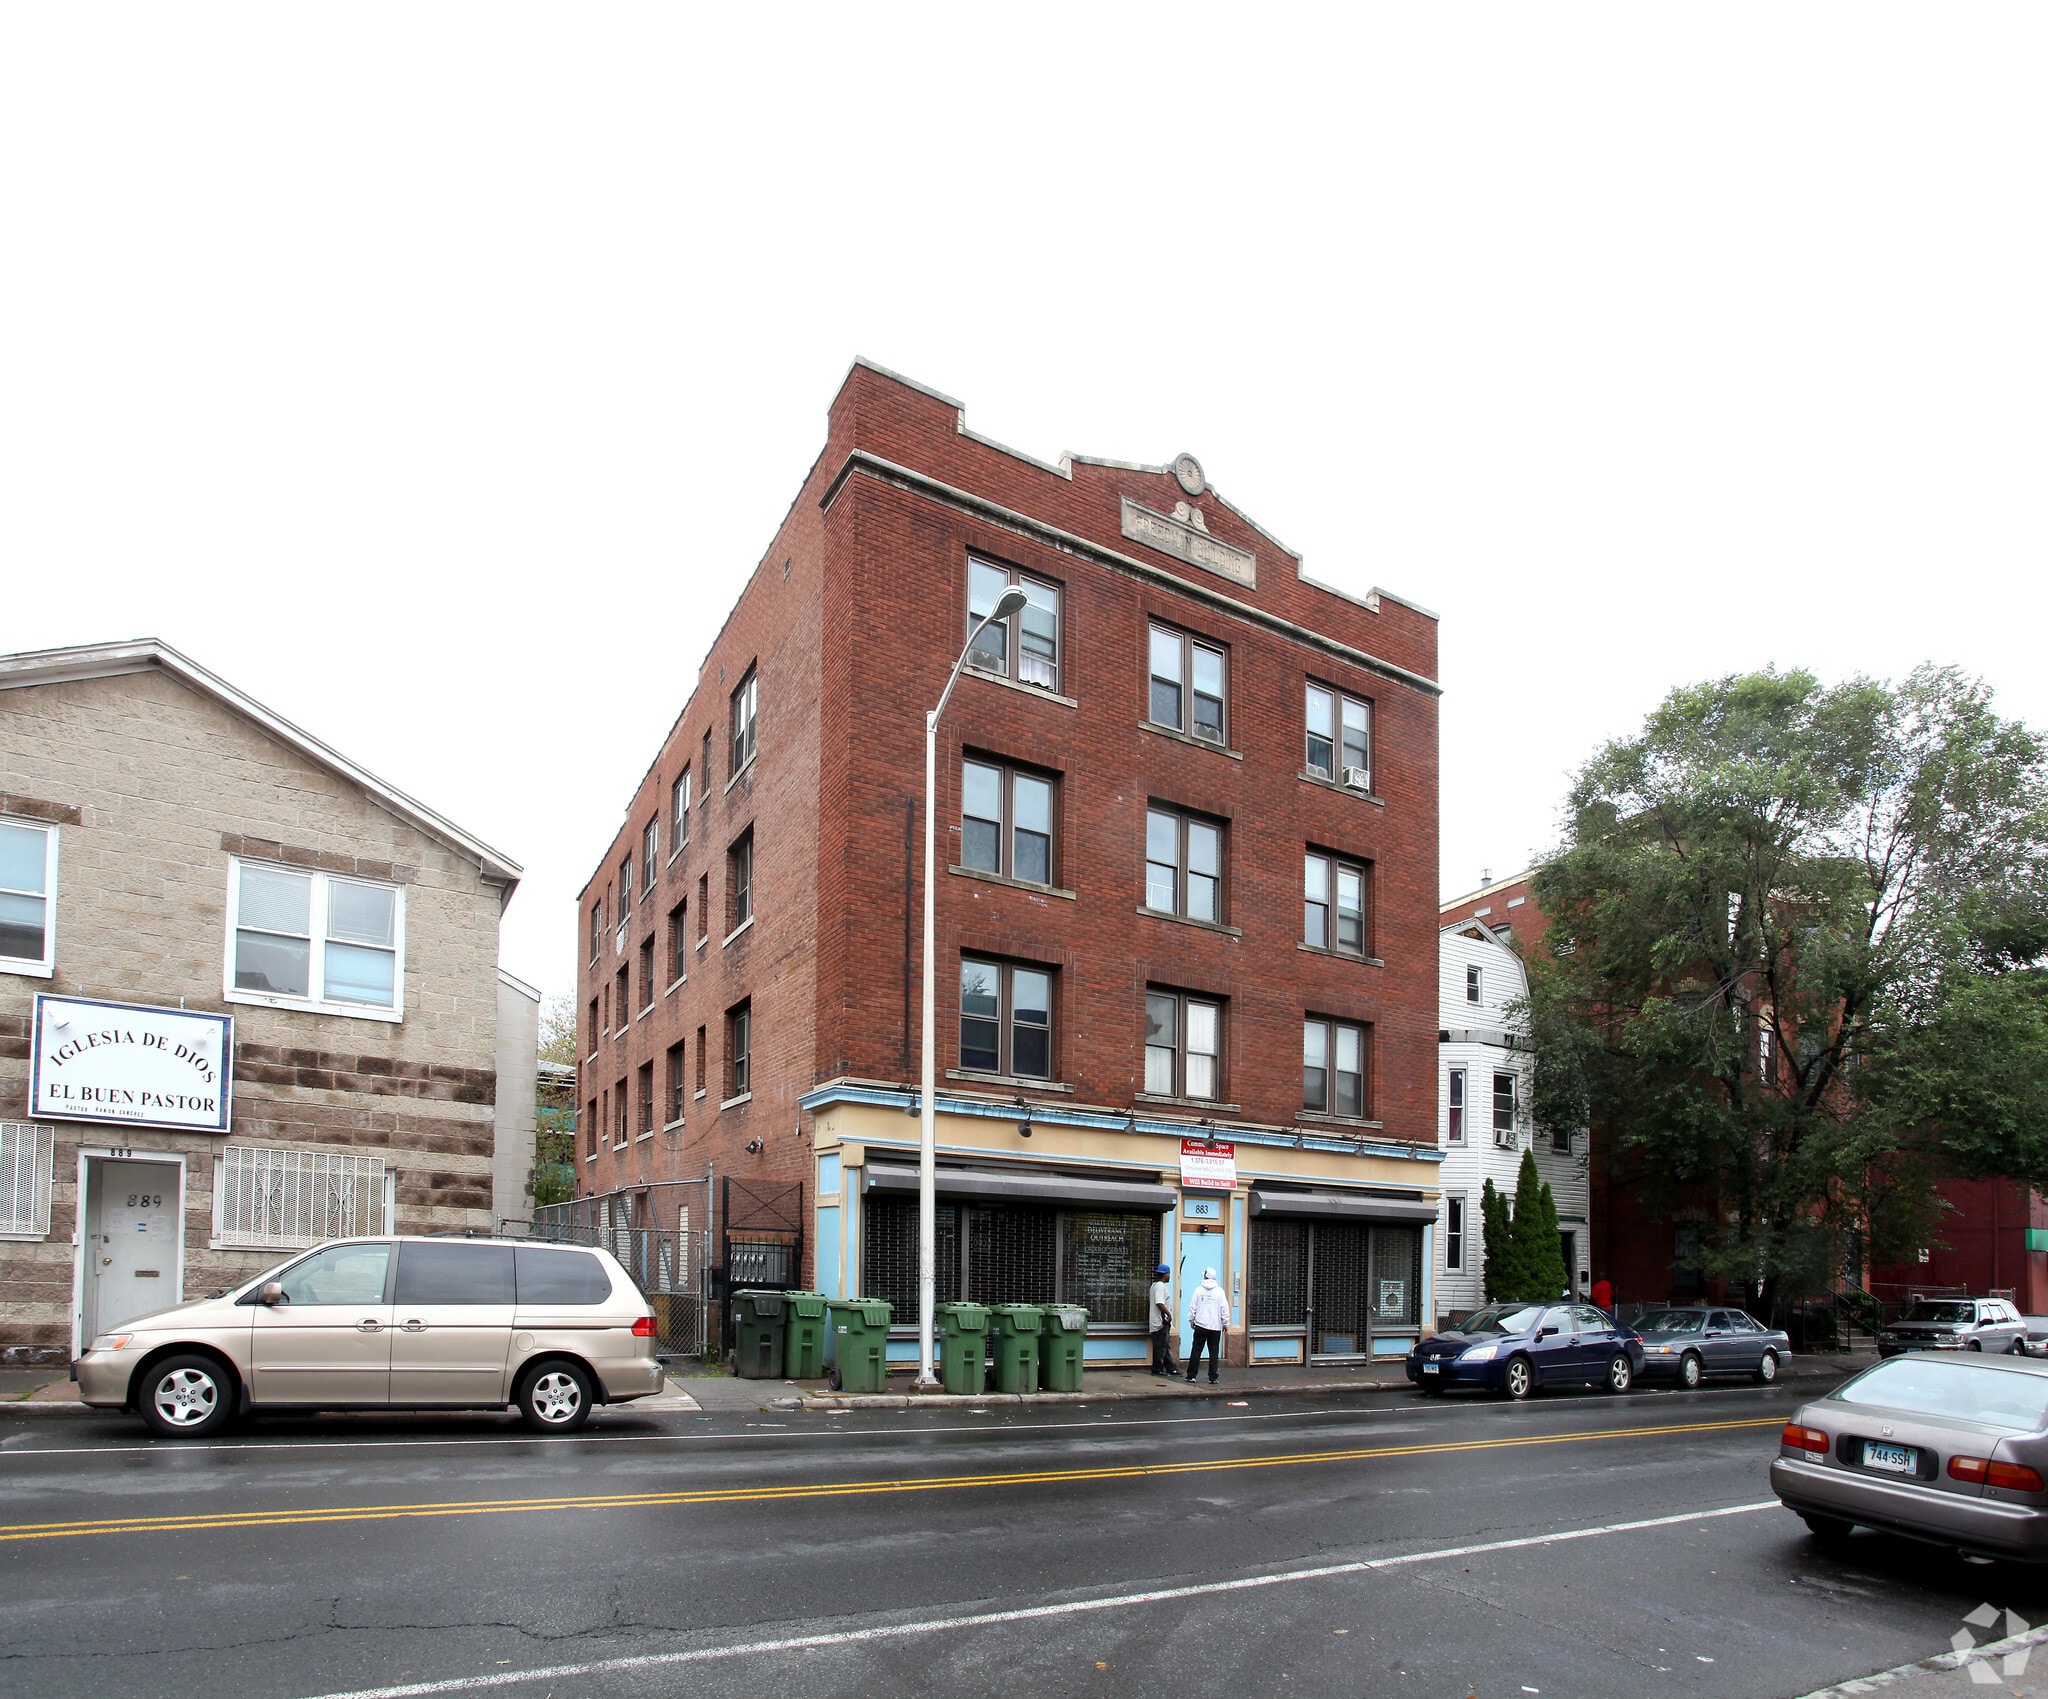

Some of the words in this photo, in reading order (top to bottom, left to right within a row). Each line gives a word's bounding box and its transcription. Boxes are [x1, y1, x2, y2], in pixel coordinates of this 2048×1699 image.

[1197, 541, 1241, 574] BUILDING
[49, 1029, 135, 1067] IGLESIA
[142, 1032, 169, 1051] DE
[174, 1044, 217, 1083] DIOS
[49, 1083, 75, 1099] EL
[81, 1086, 135, 1104] BUEN
[141, 1091, 215, 1112] PASTOR
[65, 1104, 88, 1112] PASTOR
[95, 1106, 115, 1114] RAMON
[110, 1148, 132, 1157] 889
[1205, 1150, 1232, 1159] Immediately
[1201, 1178, 1214, 1186] Build
[126, 1194, 162, 1208] 889
[1195, 1204, 1209, 1215] 883
[1090, 1234, 1124, 1242] OUTREACH
